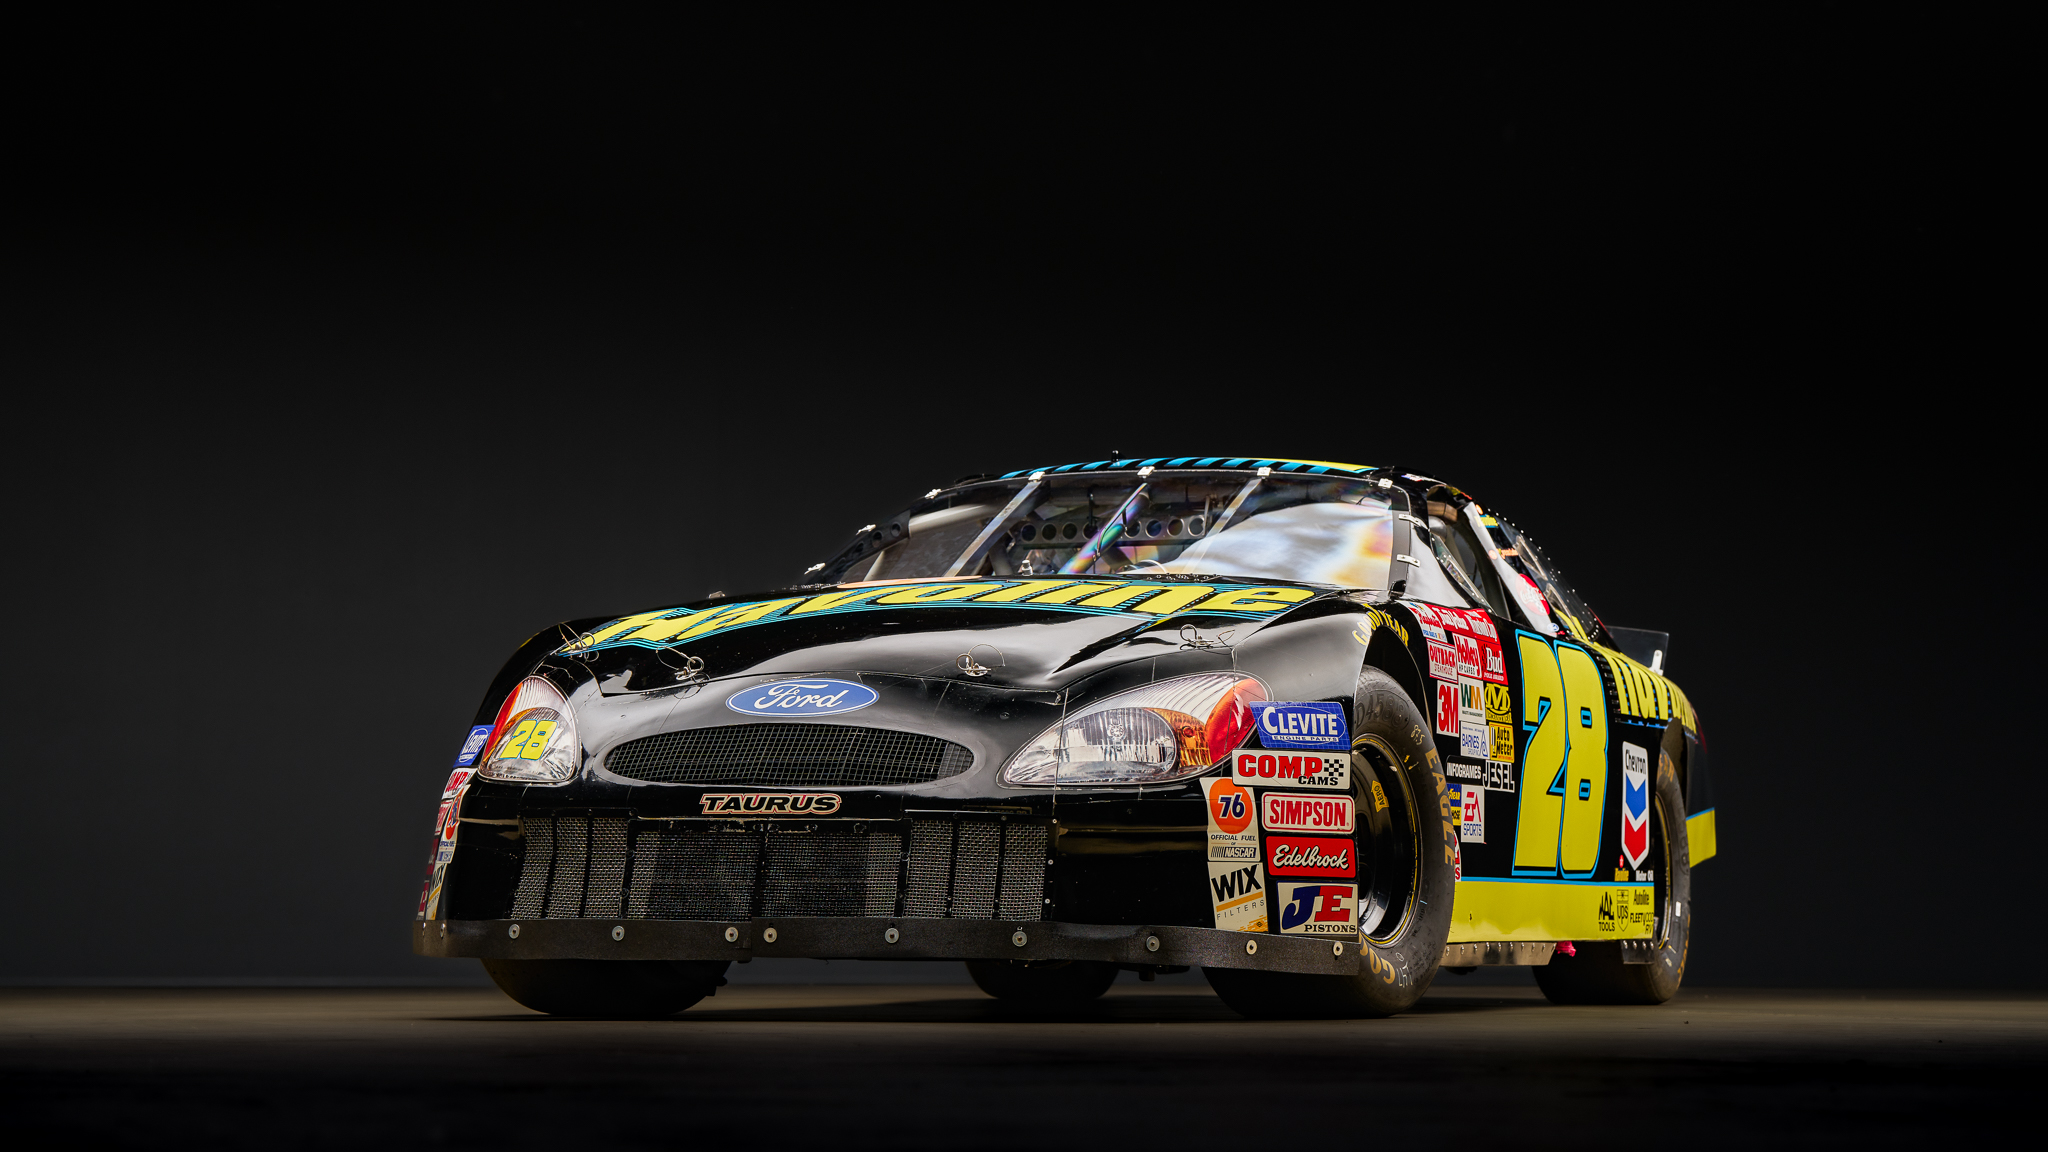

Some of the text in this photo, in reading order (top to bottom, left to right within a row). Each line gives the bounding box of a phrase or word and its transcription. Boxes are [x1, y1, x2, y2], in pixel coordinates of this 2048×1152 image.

[560, 580, 1315, 653] Havoline
[1352, 603, 1409, 647] GOODYEAR
[1429, 644, 1456, 669] OUTBACK
[1485, 647, 1504, 675] Bud
[754, 684, 849, 710] Ford
[1438, 684, 1459, 734] 3M
[1460, 683, 1483, 711] WM
[1262, 706, 1339, 736] CLEVITE
[499, 719, 558, 760] 28
[1462, 733, 1480, 749] BARNES
[1497, 727, 1510, 742] Auto
[1497, 741, 1514, 757] Meter
[1512, 629, 1608, 879] 28
[1238, 754, 1323, 779] COMP
[1447, 762, 1482, 779] INFOGRAMES
[1625, 750, 1647, 775] Chevron
[1298, 776, 1339, 786] CAMS
[1482, 760, 1515, 793] JESEL
[700, 793, 842, 814] TAURUS
[1218, 793, 1246, 819] 76
[1373, 785, 1386, 806] AERO
[1425, 747, 1456, 867] EAGLE
[1463, 791, 1482, 822] EA
[1269, 799, 1347, 827] SIMPSON
[1464, 823, 1482, 836] SPORTS
[1223, 847, 1257, 858] NASCAR
[1273, 844, 1350, 870] Edelbrock
[1211, 864, 1263, 903] WIX
[1216, 899, 1265, 920] FILTERS
[1282, 885, 1354, 930] JE
[1304, 924, 1357, 933] PISTONS
[1599, 922, 1616, 932] TOOLS
